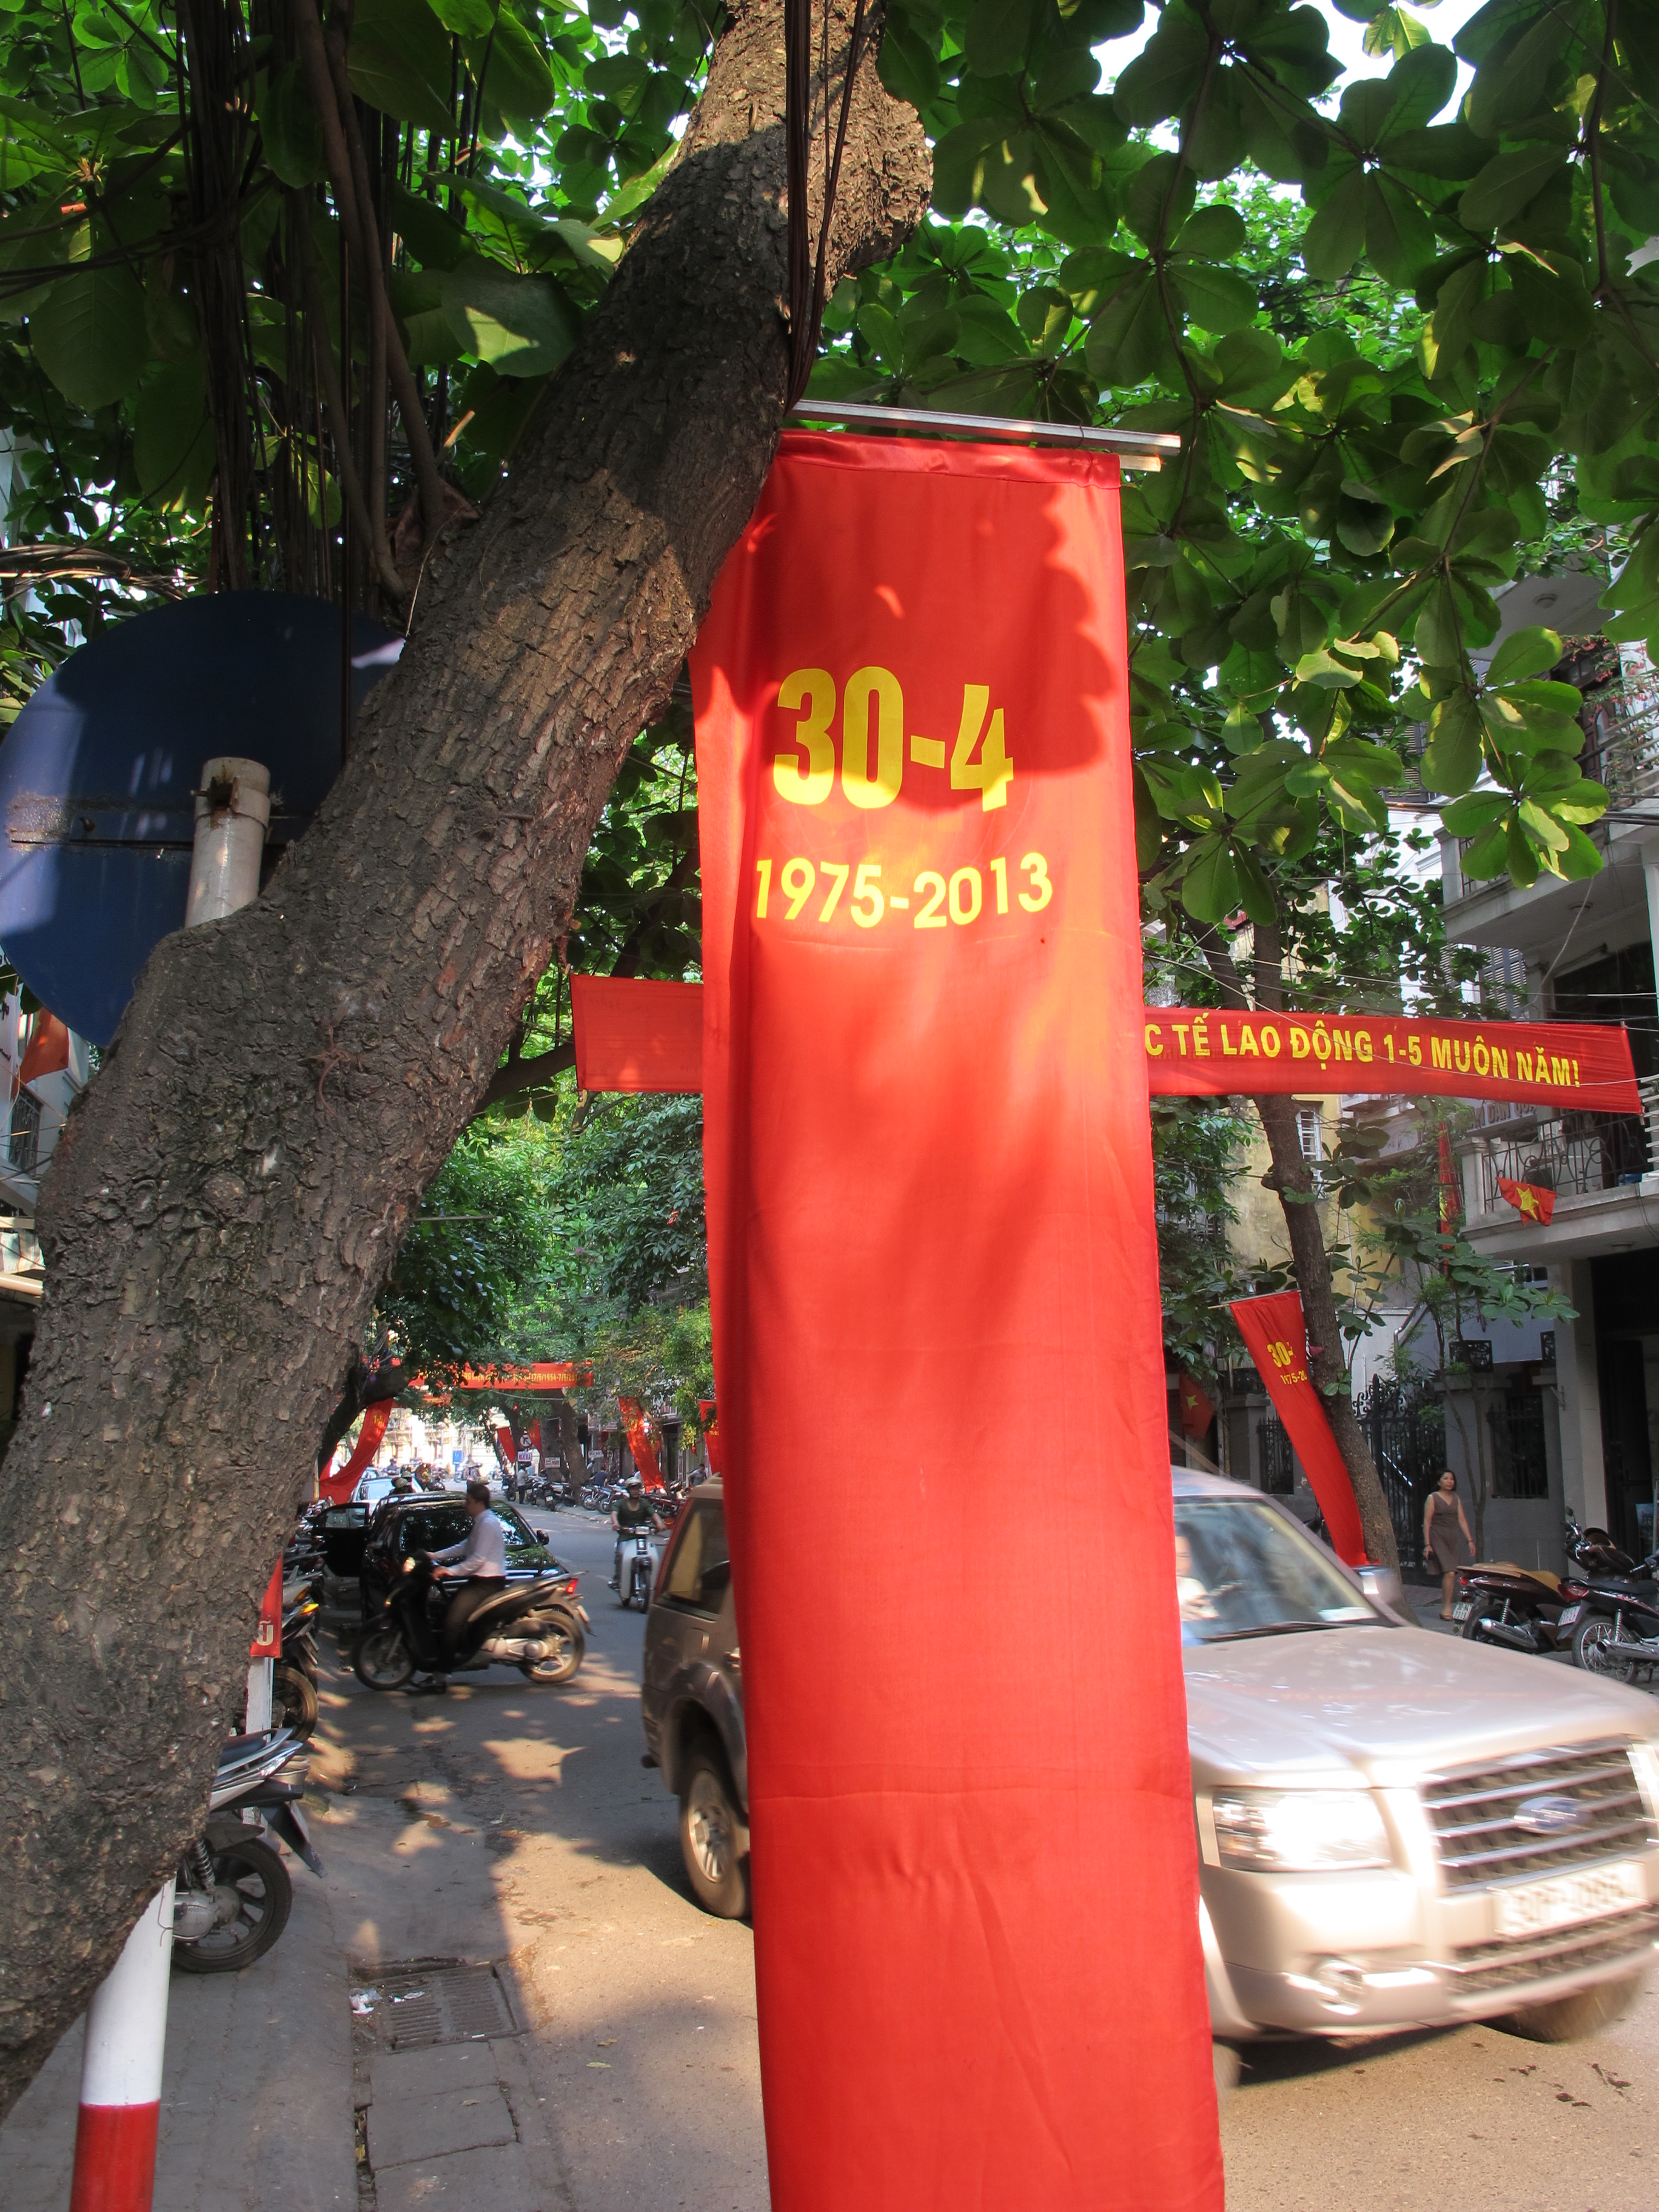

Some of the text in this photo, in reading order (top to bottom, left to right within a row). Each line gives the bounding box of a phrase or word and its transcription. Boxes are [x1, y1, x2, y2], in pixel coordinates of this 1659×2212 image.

[773, 666, 1014, 813] 30-4
[756, 852, 1053, 929] 1975-2013
[1171, 1012, 1211, 1056] TẾ
[1221, 1024, 1282, 1057] LAO
[1290, 1020, 1374, 1070] ĐỘNG
[1383, 1034, 1422, 1067] 1-5
[1430, 1035, 1509, 1079] MUÔN
[1515, 1046, 1581, 1088] NĂM!
